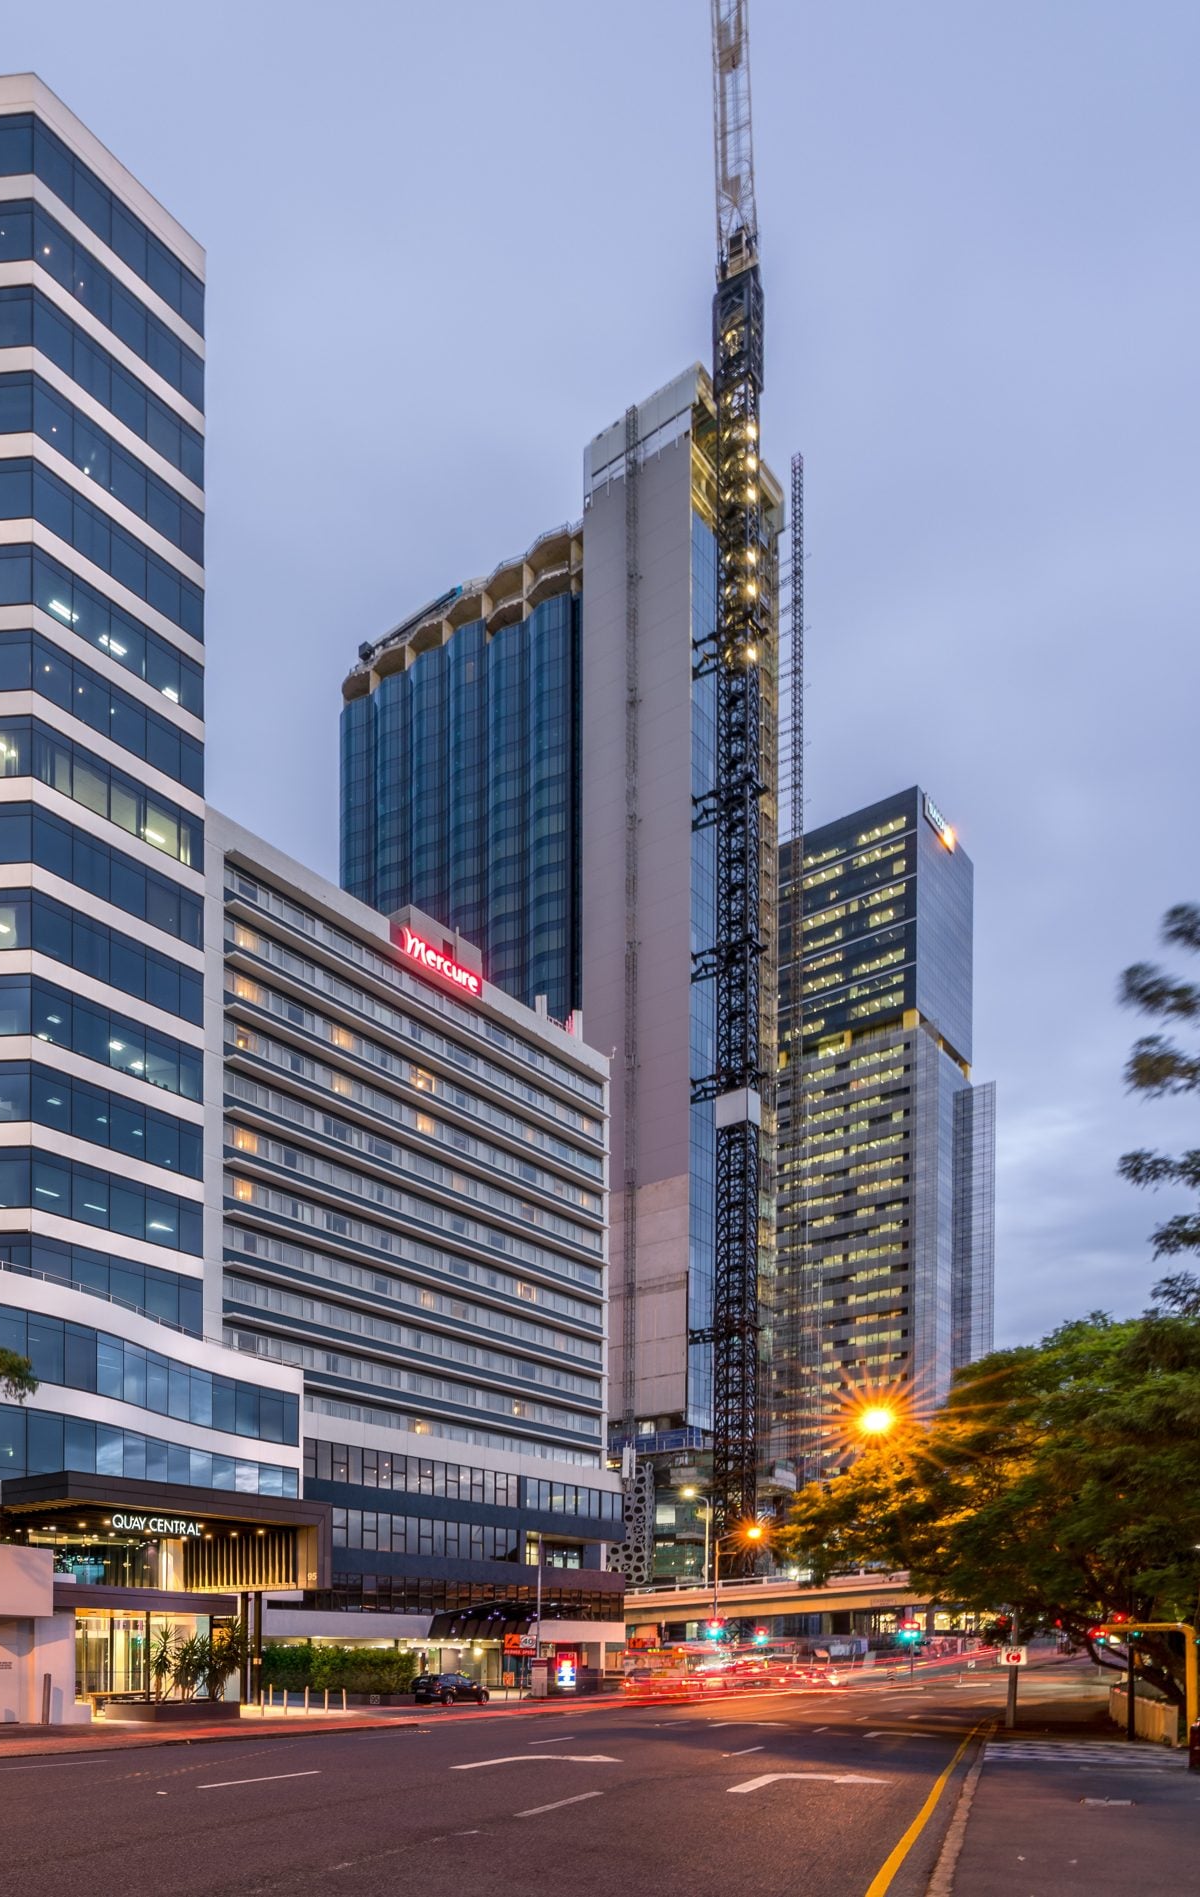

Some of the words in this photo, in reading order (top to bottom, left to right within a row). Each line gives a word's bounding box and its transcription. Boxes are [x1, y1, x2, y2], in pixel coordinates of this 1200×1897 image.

[403, 927, 478, 993] Mercure
[112, 1514, 147, 1531] QUAY
[149, 1518, 201, 1536] CENTRAL
[307, 1572, 318, 1581] 95
